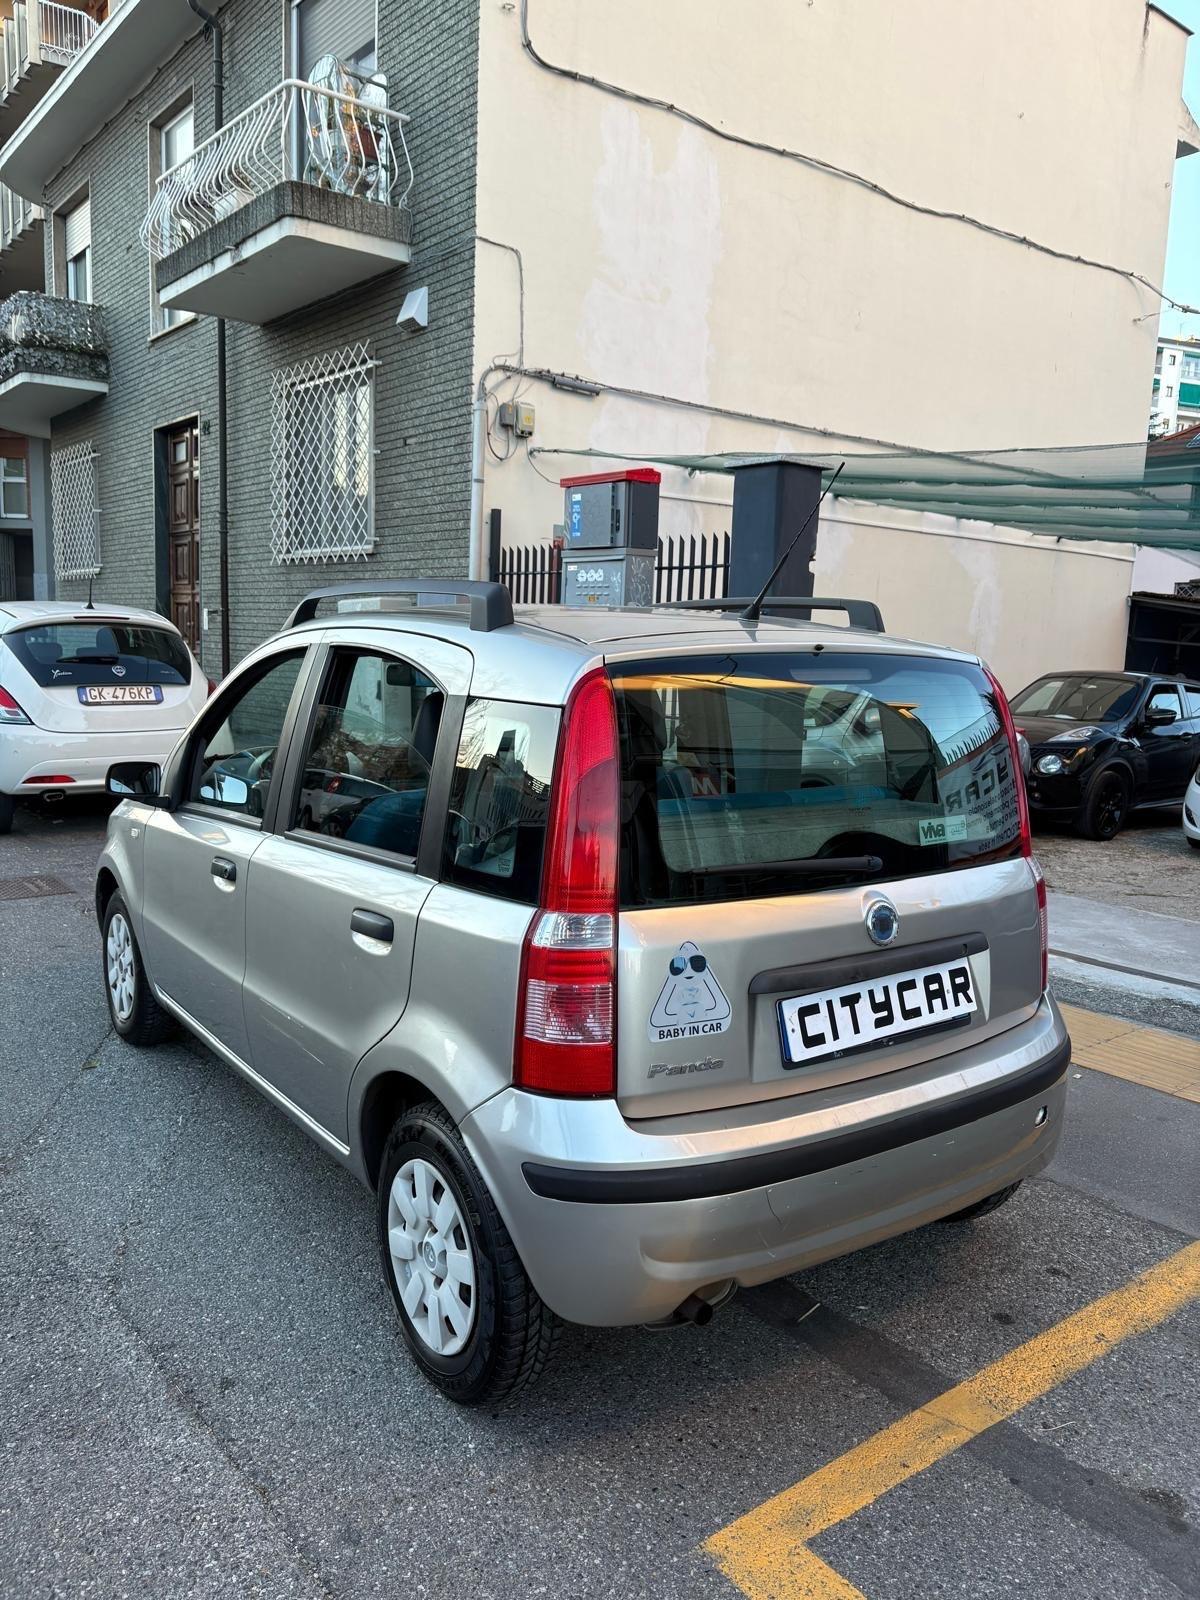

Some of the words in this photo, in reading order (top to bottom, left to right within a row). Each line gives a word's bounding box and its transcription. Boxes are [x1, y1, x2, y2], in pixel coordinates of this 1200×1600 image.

[797, 966, 974, 1050] CITYCAR
[658, 1026, 687, 1040] BABY
[689, 1025, 700, 1036] IN
[701, 1022, 722, 1034] CAR
[647, 1055, 724, 1079] Panda
